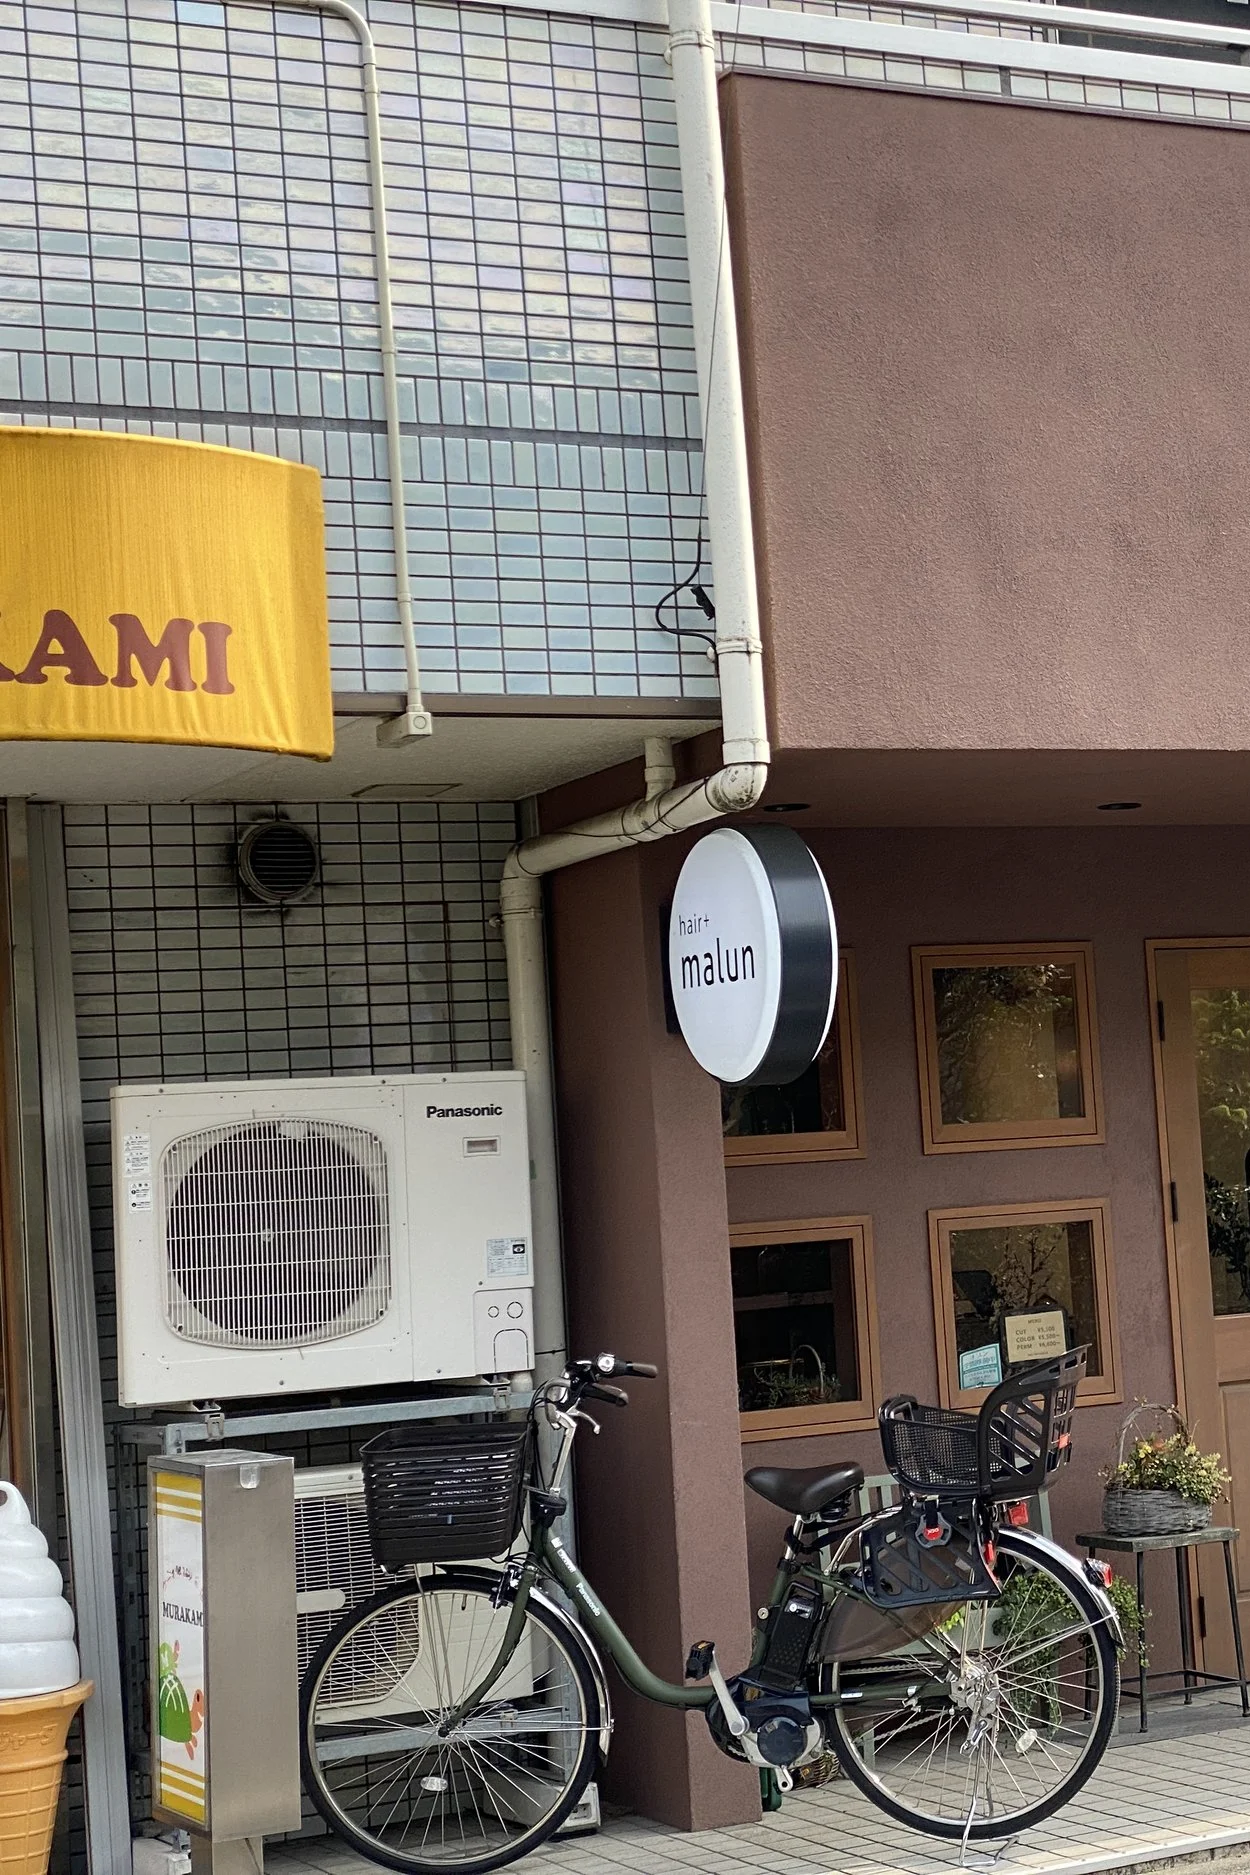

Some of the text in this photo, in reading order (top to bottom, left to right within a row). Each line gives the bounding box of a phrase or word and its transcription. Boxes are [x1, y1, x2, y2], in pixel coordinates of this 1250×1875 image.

[0, 609, 236, 695] AMI
[681, 937, 755, 989] malun
[426, 1103, 503, 1118] Panasonic
[162, 1601, 204, 1627] MURAKAM
